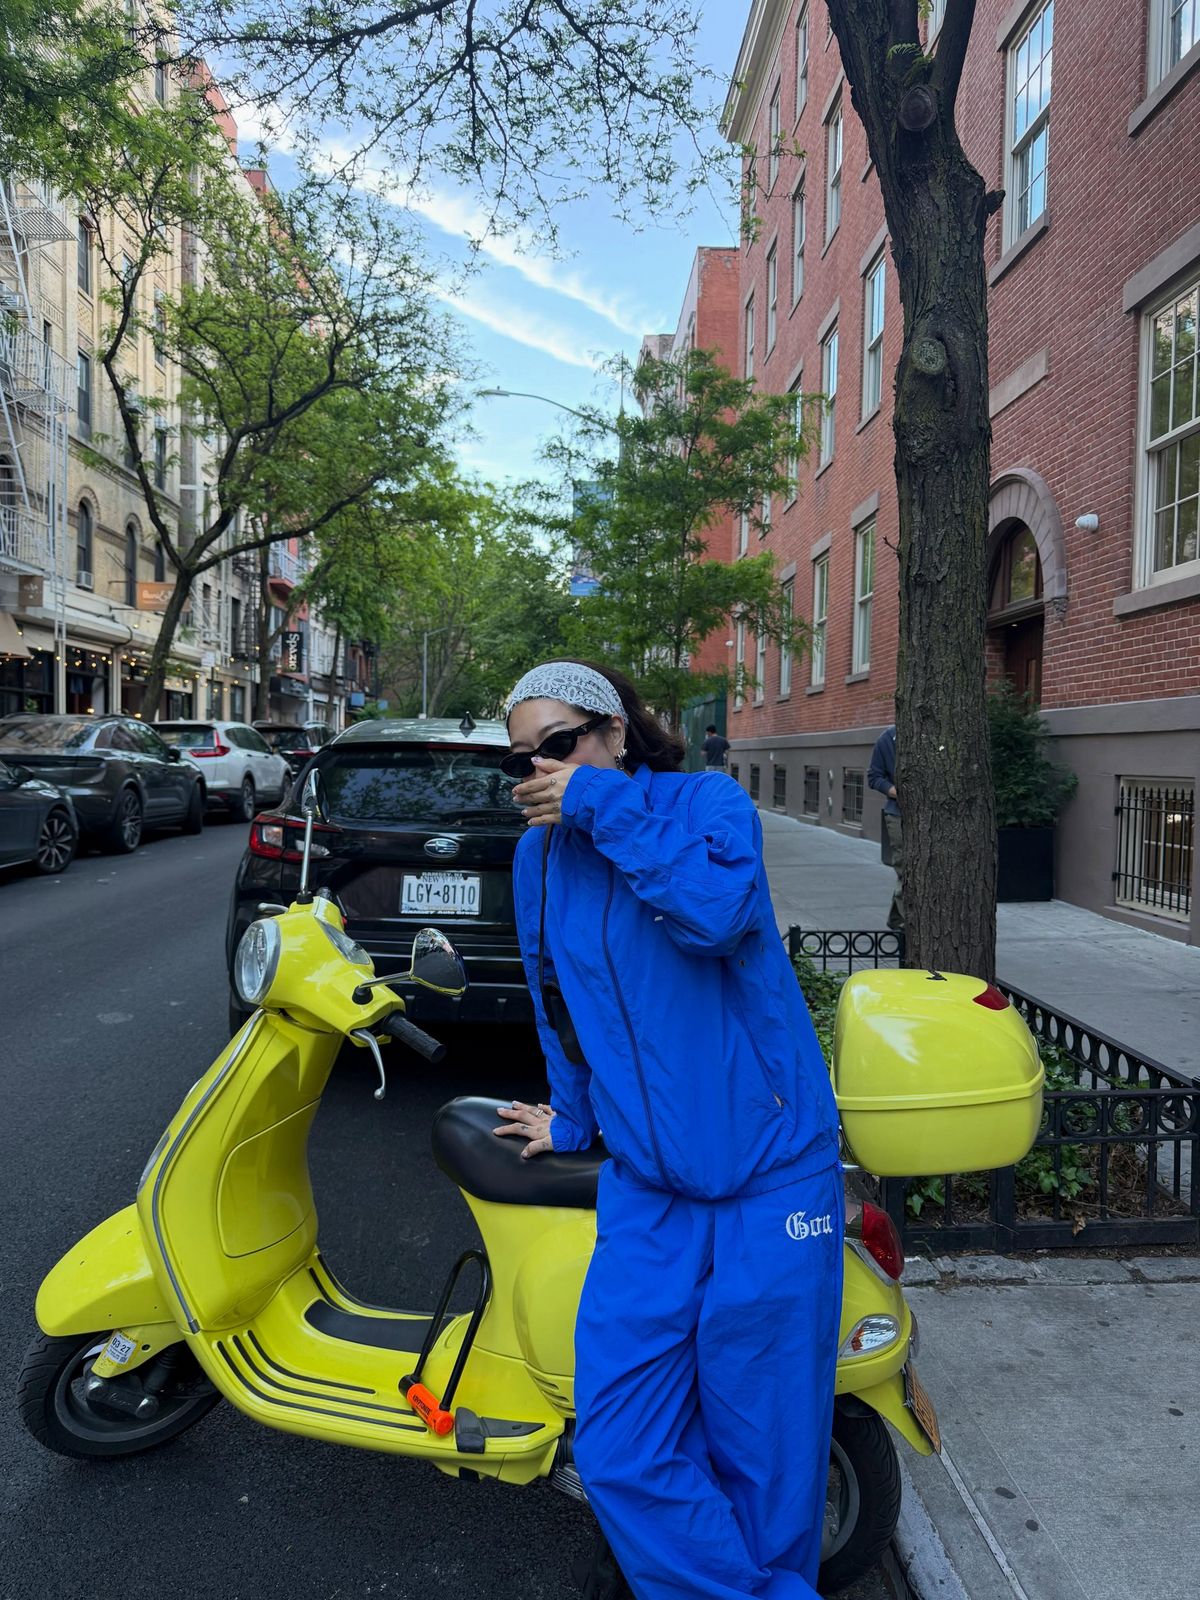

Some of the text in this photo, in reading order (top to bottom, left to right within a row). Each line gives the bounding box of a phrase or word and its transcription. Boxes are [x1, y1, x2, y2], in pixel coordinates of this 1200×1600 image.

[407, 883, 476, 905] LGY 8110
[120, 1344, 131, 1354] 27
